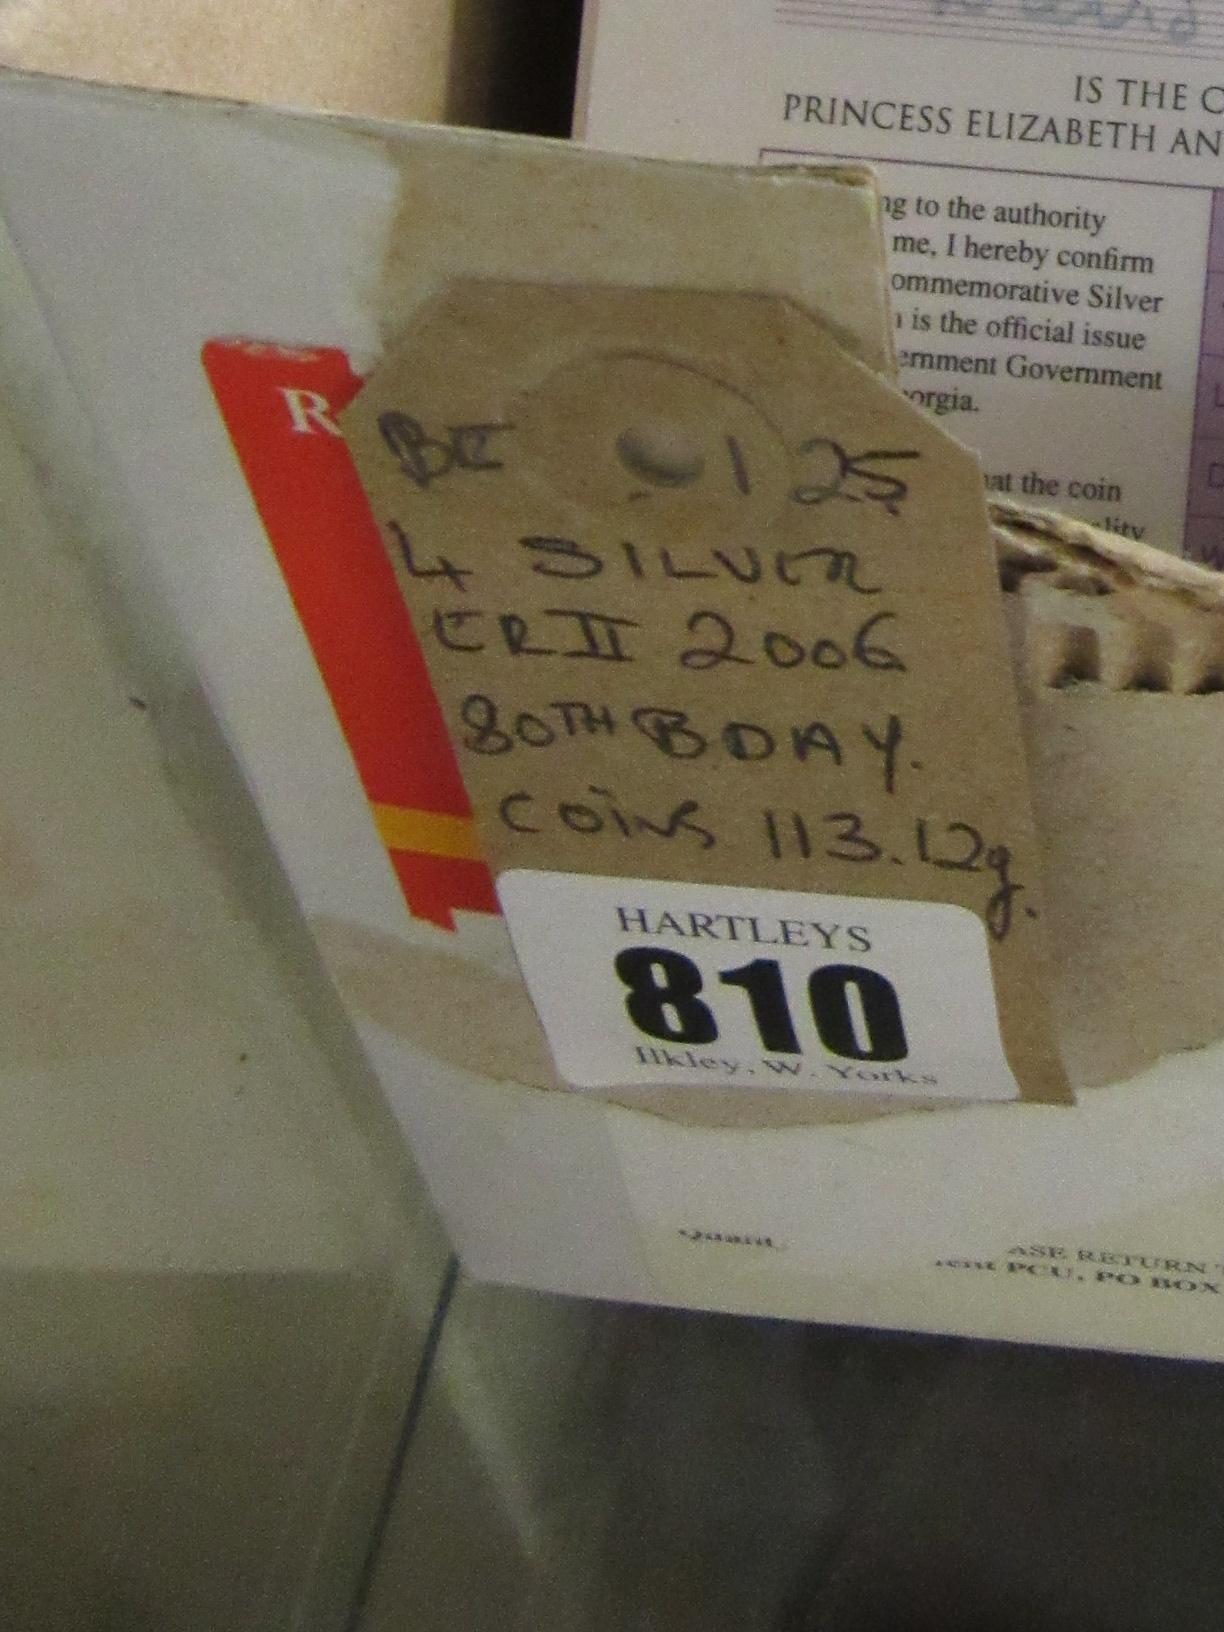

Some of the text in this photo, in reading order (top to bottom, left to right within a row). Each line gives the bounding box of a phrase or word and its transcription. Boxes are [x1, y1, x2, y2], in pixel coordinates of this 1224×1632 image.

[1074, 76, 1103, 104] IS
[1116, 80, 1188, 112] THE
[783, 93, 952, 136] PRINCESS
[967, 111, 1156, 153] ELIZABETH
[915, 196, 940, 218] to
[947, 196, 986, 221] the
[993, 202, 1106, 236] authority
[947, 234, 955, 257] I
[964, 239, 1049, 270] hereby
[1057, 247, 1154, 273] confirm
[892, 272, 1164, 313] ommemorative Silver
[912, 307, 930, 331] is
[940, 310, 977, 336] the
[986, 316, 1073, 345] official
[1082, 321, 1146, 350] issue
[899, 350, 1163, 390] ernment Government
[904, 386, 979, 416] orgia.
[1021, 472, 1058, 498] the
[1067, 477, 1121, 503] coin
[389, 520, 473, 585] 4
[680, 610, 905, 674] 2006
[616, 906, 873, 954] HARTLEYS
[613, 945, 910, 1063] 810
[827, 1063, 940, 1087] Yorks
[1077, 1248, 1207, 1275] RETURN
[1095, 1271, 1140, 1287] PO
[1151, 1277, 1220, 1295] BOX
